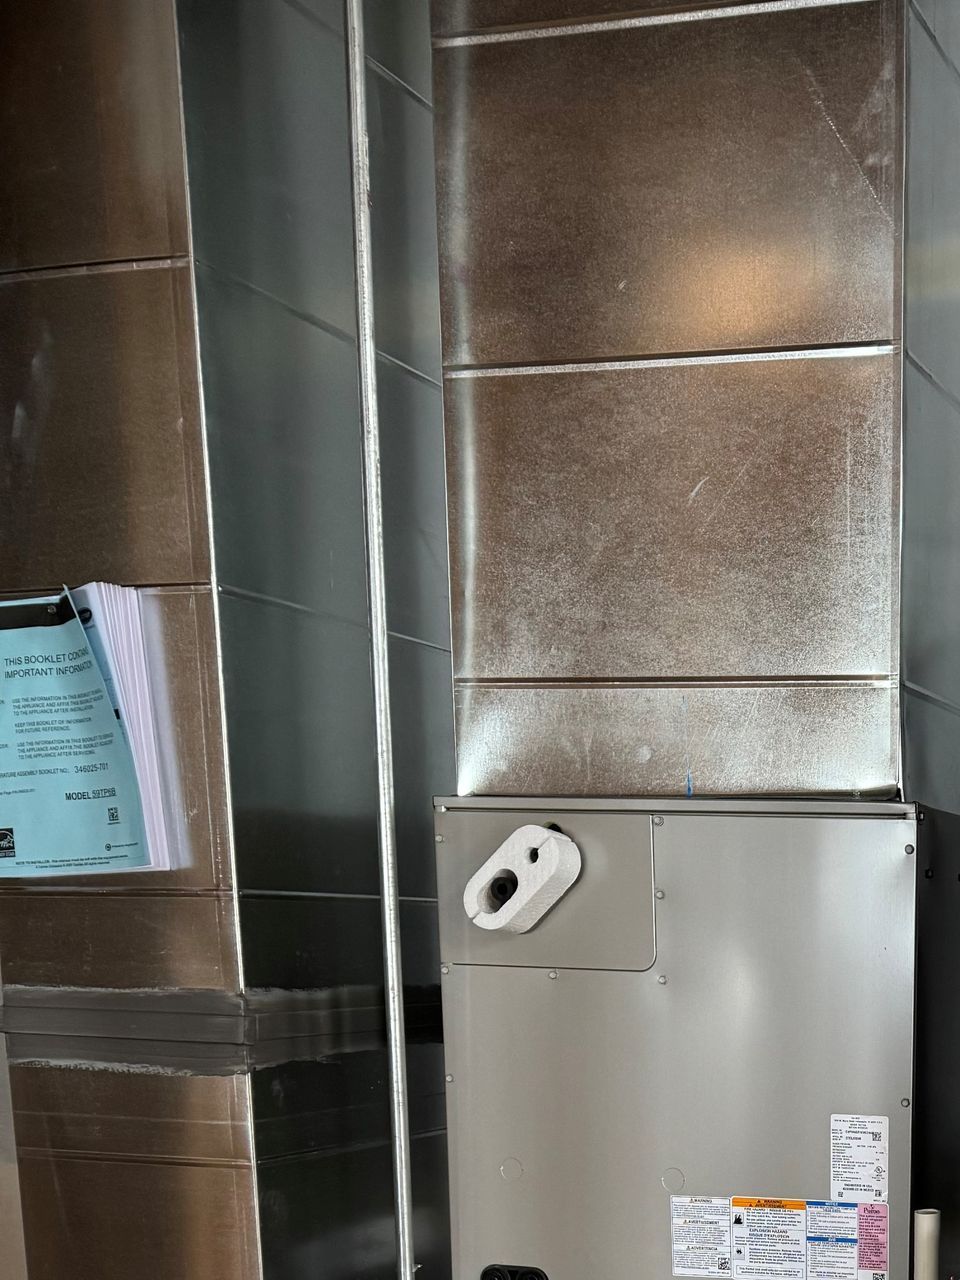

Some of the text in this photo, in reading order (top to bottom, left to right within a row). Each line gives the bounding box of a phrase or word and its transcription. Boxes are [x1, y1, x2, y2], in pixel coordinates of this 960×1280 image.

[4, 657, 22, 666] THIS
[25, 654, 65, 664] BOOKLET
[5, 667, 53, 678] IMPORTANT
[65, 792, 91, 801] MODEL
